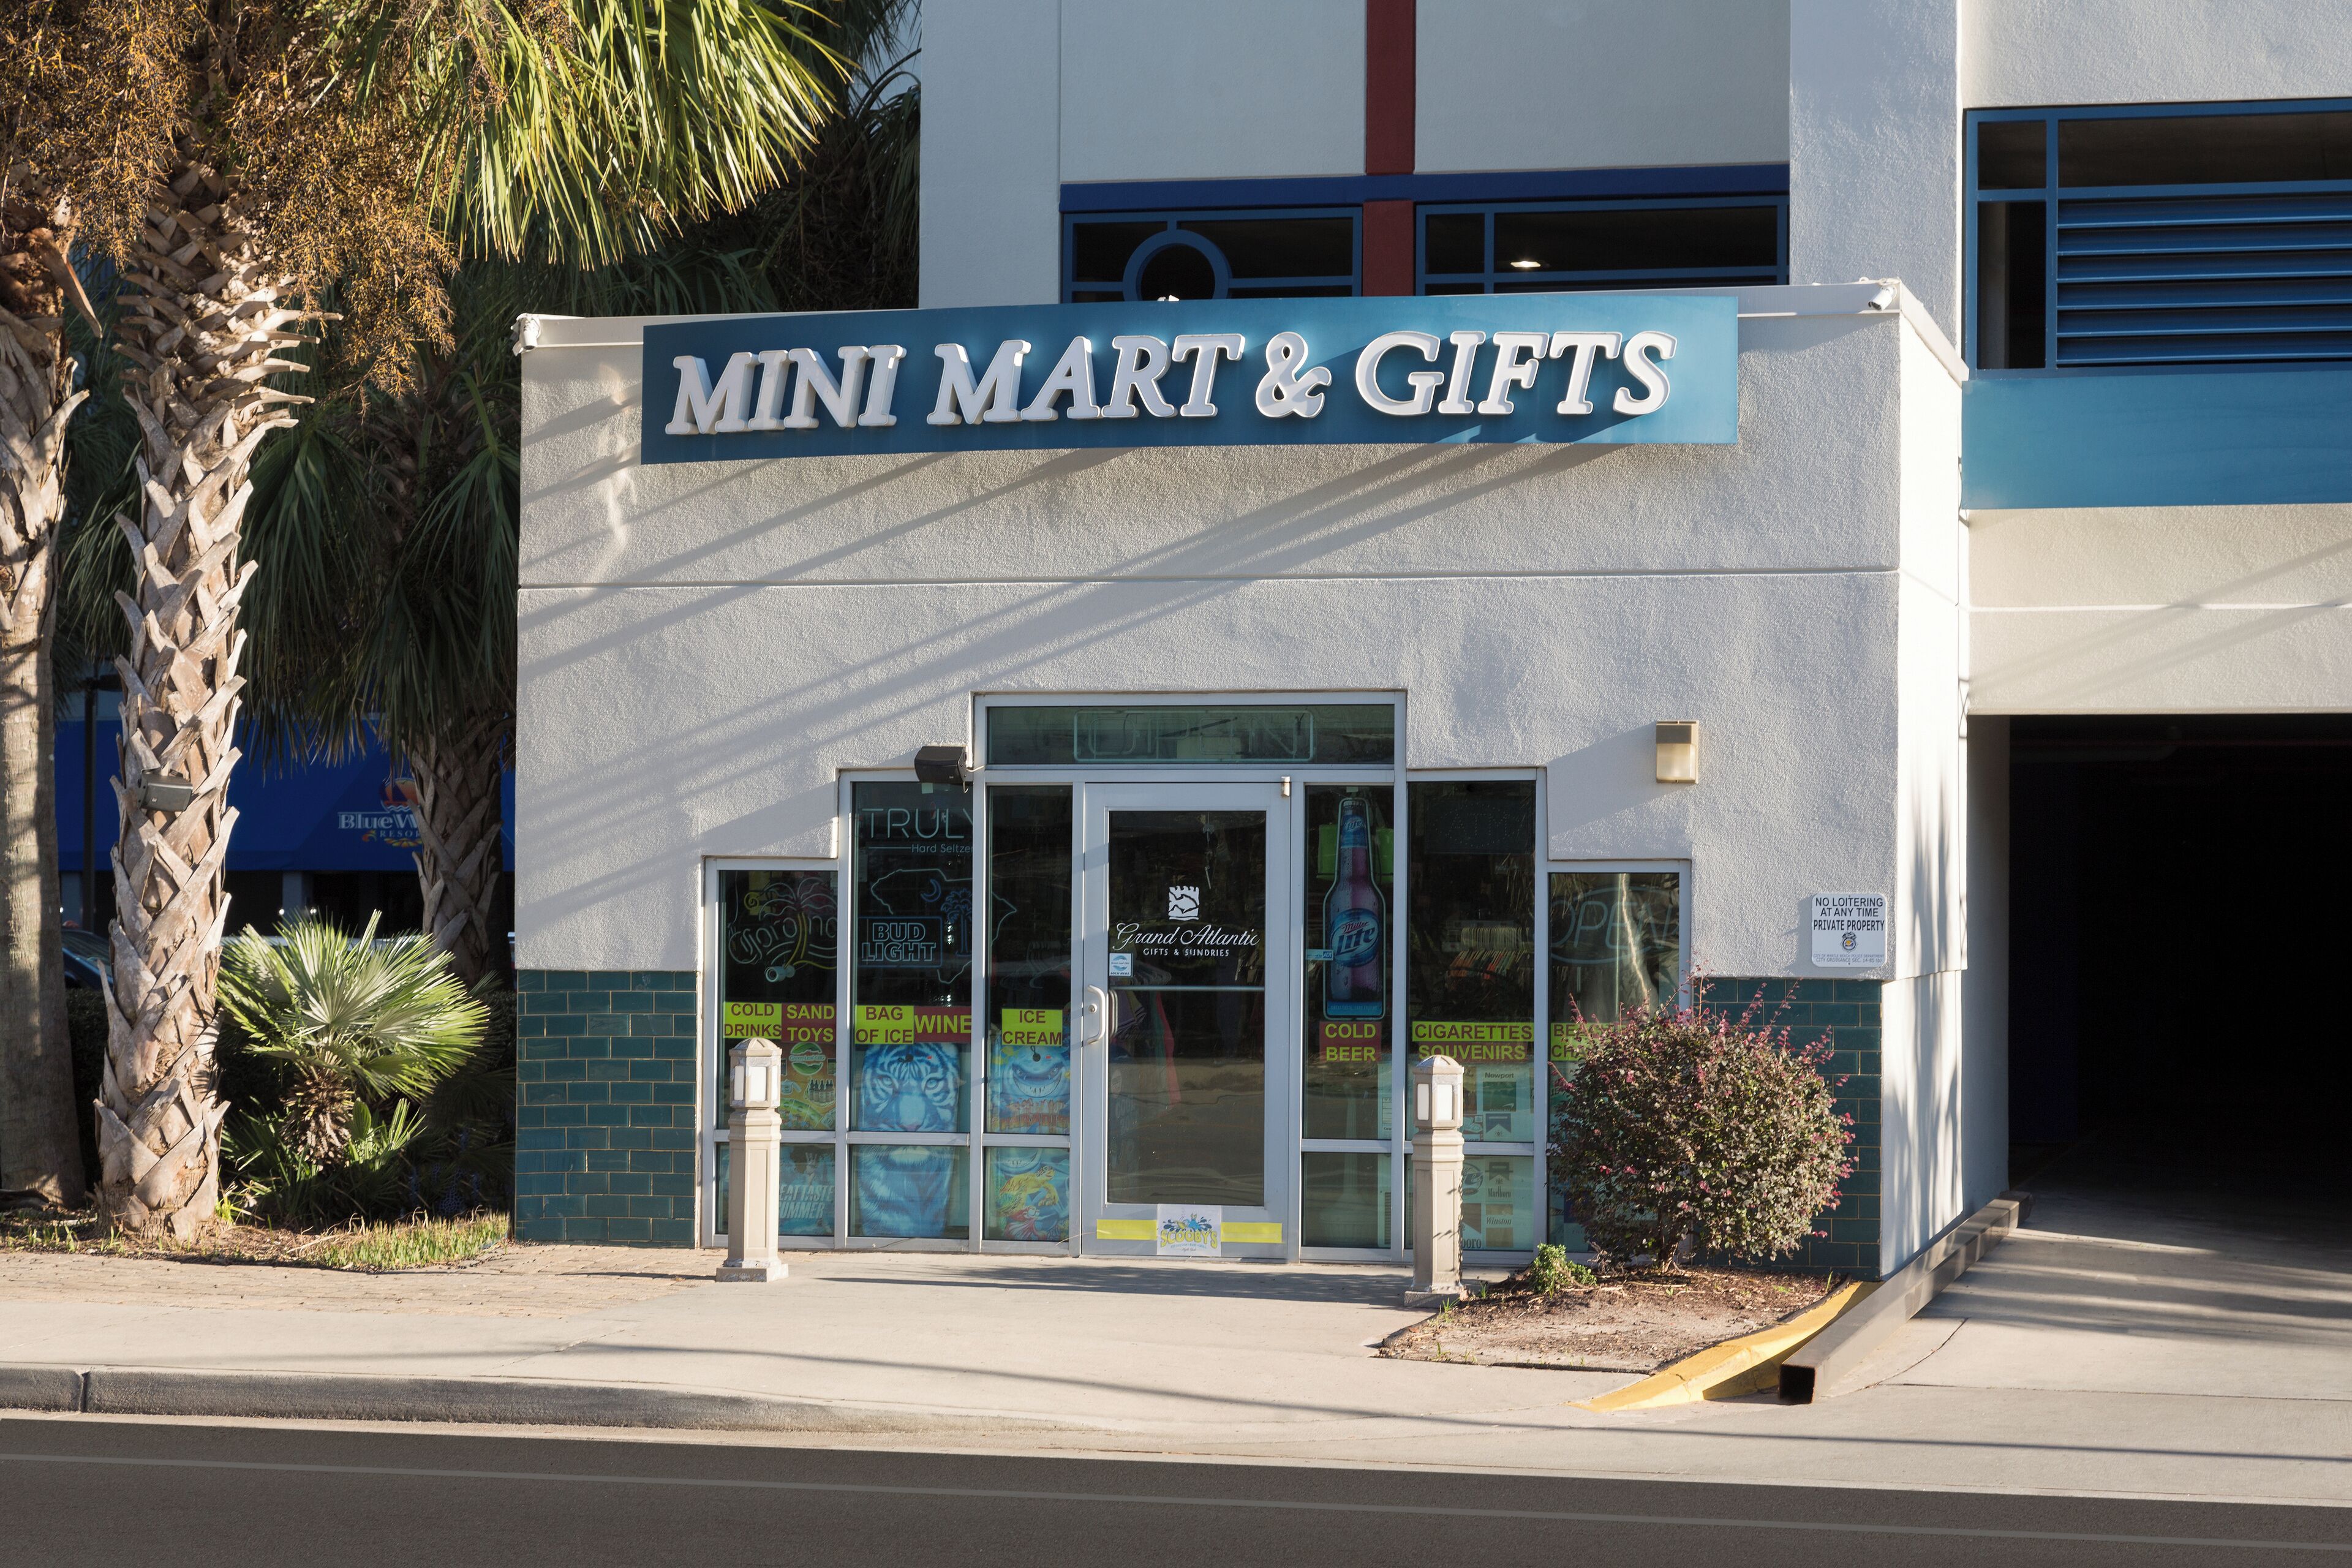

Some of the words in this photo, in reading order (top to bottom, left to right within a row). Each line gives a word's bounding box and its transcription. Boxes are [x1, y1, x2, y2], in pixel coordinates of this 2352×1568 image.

[665, 345, 907, 435] MINI
[926, 333, 1246, 425] MART
[1255, 331, 1333, 419] &
[1355, 331, 1678, 417] GIFTS
[1088, 716, 1298, 755] OPEN
[911, 843, 937, 853] Hard
[1815, 897, 1830, 907] NO
[1833, 897, 1883, 907] LOITERING
[1820, 907, 1832, 917] AT
[1833, 907, 1854, 917] ANY
[1856, 907, 1879, 918] TIME
[872, 922, 926, 942] BUD
[1341, 921, 1370, 934] Miller
[1813, 919, 1845, 930] PRIVATE
[1847, 919, 1885, 931] PROPERTY
[1112, 922, 1181, 951] Grand
[1180, 924, 1261, 946] Atlantic
[1335, 927, 1376, 956] Lite
[861, 941, 937, 962] LIGHT
[1143, 948, 1168, 956] GIFTS
[1185, 948, 1229, 957] SUNDRIES
[731, 1003, 775, 1016] COLD
[786, 1005, 835, 1020] SAND
[865, 1006, 903, 1021] BAG
[1019, 1010, 1046, 1023] ICE
[725, 1023, 782, 1037] DRINKS
[914, 1014, 972, 1034] WINE
[1325, 1023, 1376, 1038] COLD
[787, 1027, 834, 1042] TOYS
[856, 1028, 879, 1043] OF
[885, 1029, 913, 1043] ICE
[1002, 1031, 1062, 1045] CREAM
[1414, 1024, 1532, 1040] CIGARETTES
[1326, 1046, 1376, 1061] BEER
[1419, 1044, 1526, 1060] SOUVENIRS
[800, 1185, 835, 1202] TASTE
[780, 1201, 825, 1219] UMMER
[1486, 1216, 1512, 1225] Winston
[1160, 1228, 1218, 1249] SCOOBY'S
